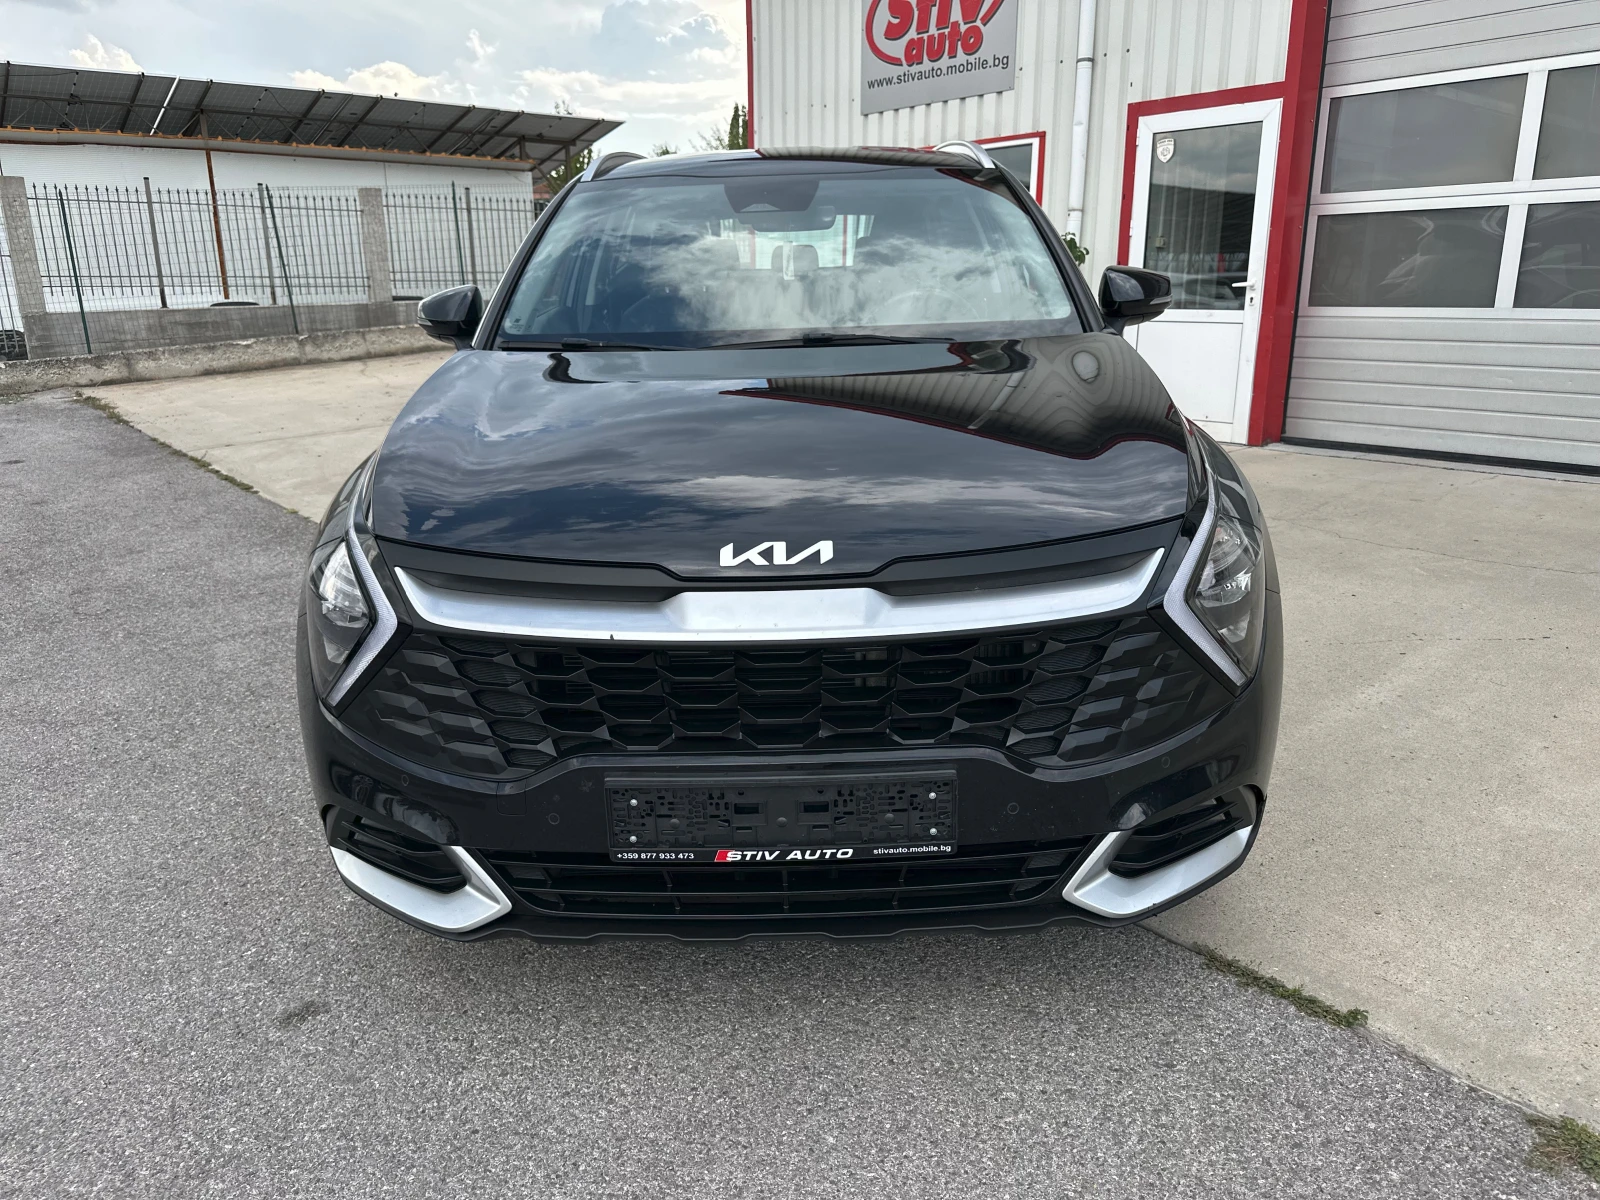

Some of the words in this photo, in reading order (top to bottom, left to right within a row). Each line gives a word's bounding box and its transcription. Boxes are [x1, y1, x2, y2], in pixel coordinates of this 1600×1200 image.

[904, 20, 984, 67] auto
[867, 54, 1010, 90] www.stivauto.mobile.bg
[677, 852, 695, 860] 473
[726, 850, 780, 861] STIV
[785, 848, 854, 860] AUTO
[873, 845, 951, 855] stivauto.mobile.bg
